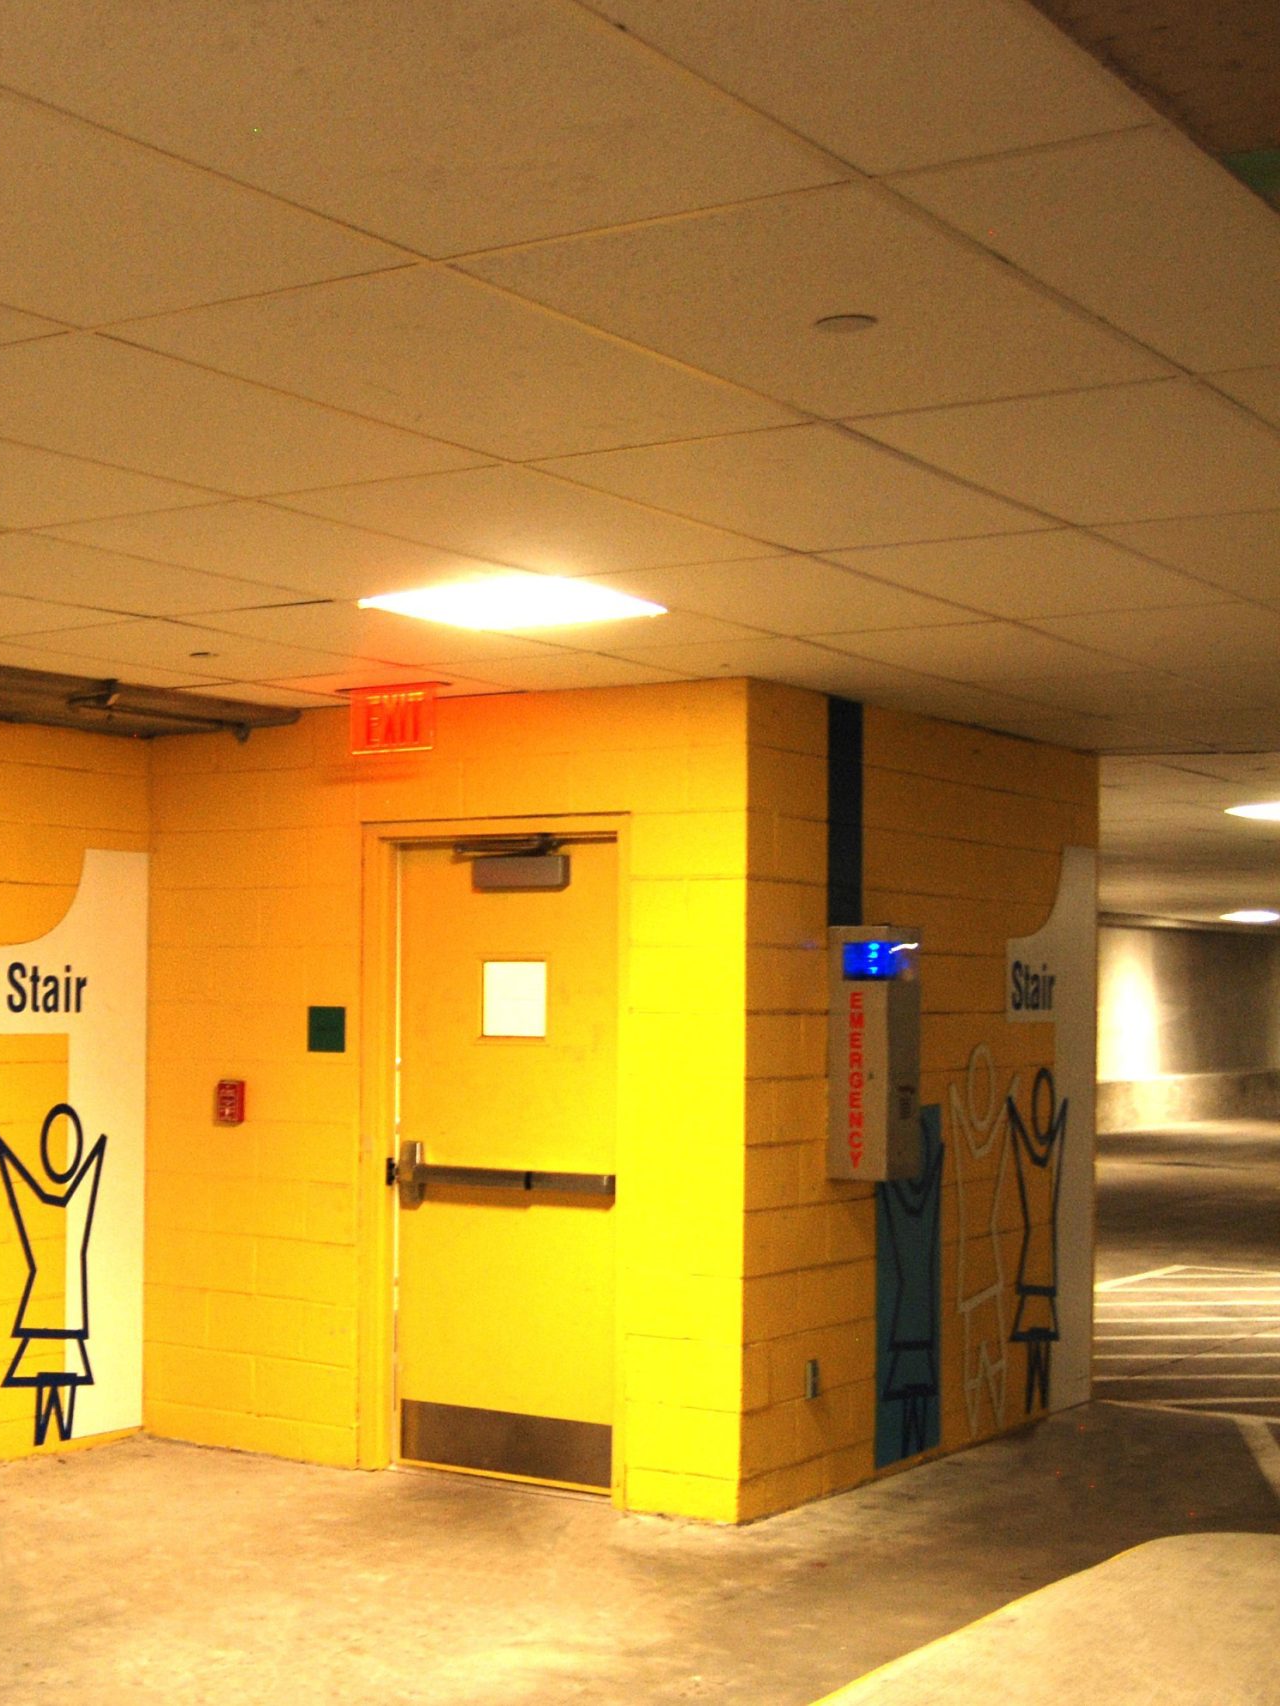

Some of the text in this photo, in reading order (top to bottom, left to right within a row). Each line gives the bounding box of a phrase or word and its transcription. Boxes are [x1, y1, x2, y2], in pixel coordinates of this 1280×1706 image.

[366, 692, 424, 749] EXIT
[7, 961, 87, 1013] Stair
[1011, 960, 1055, 1010] Stair
[849, 992, 864, 1168] EMERGENCY
